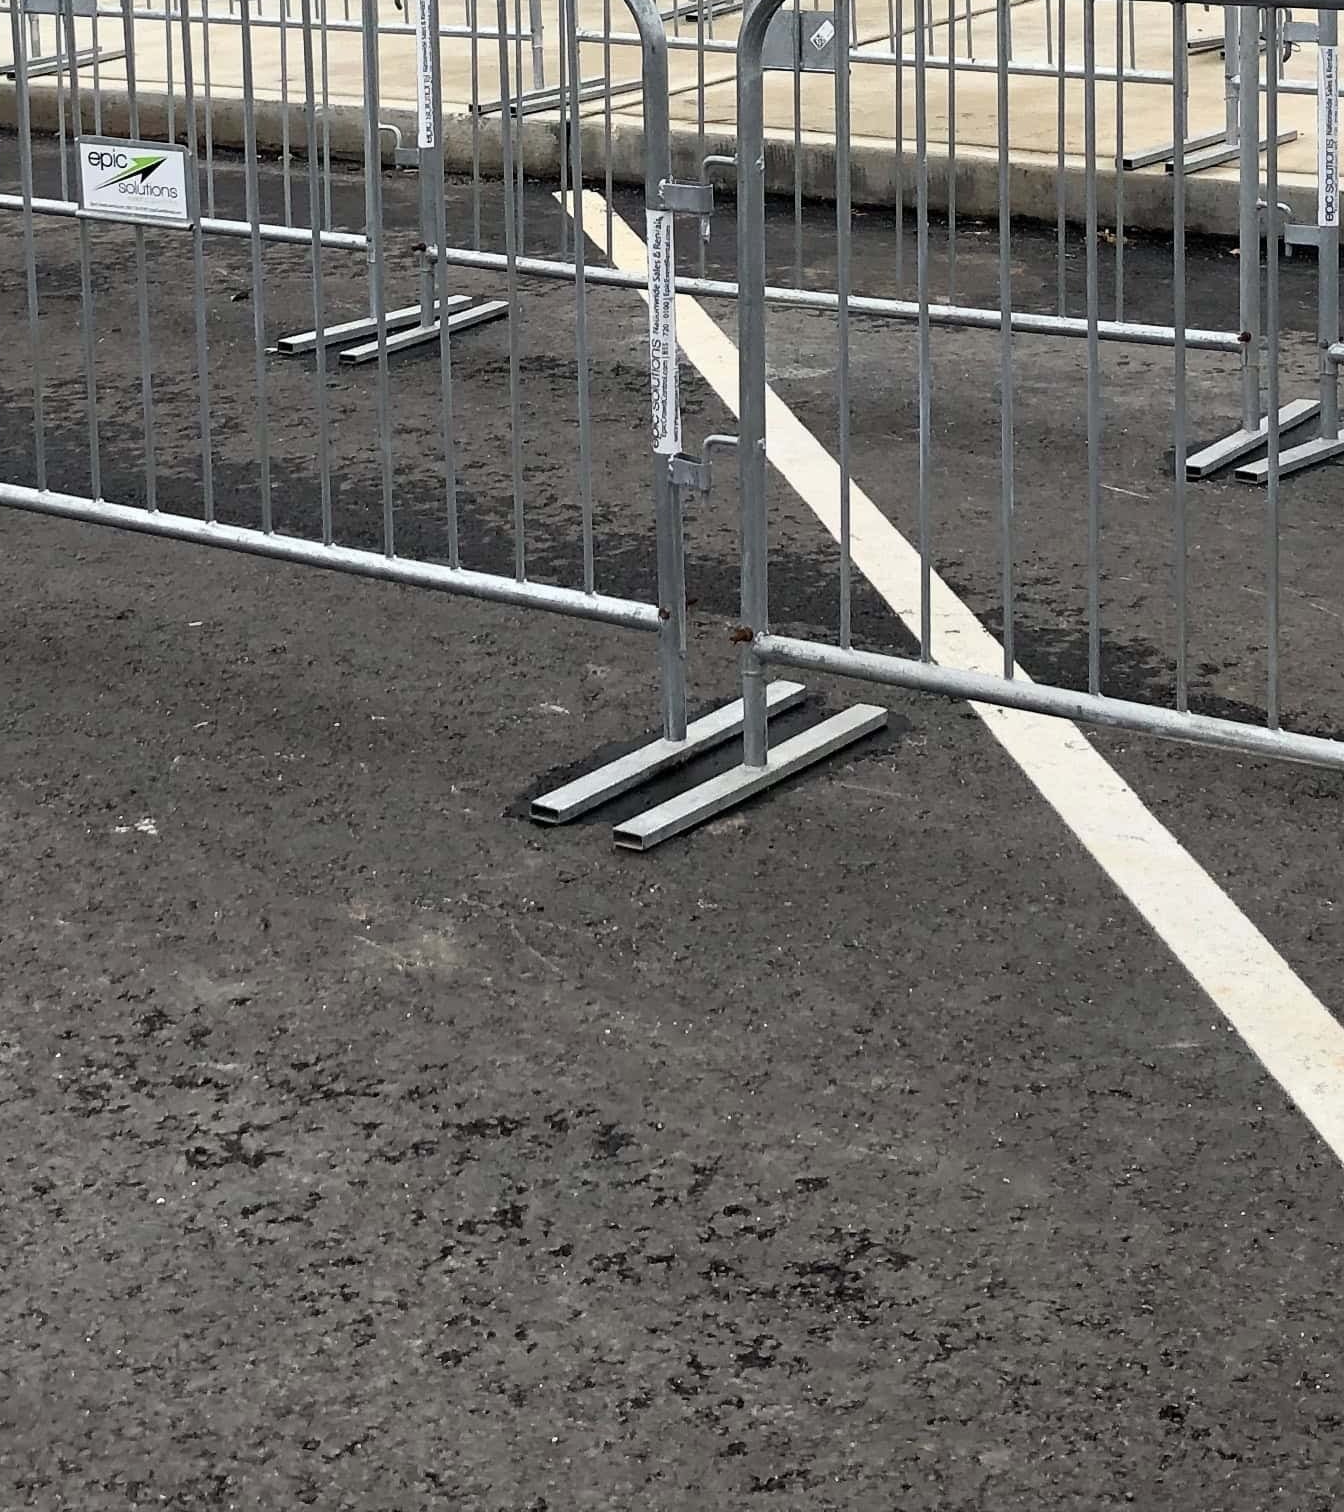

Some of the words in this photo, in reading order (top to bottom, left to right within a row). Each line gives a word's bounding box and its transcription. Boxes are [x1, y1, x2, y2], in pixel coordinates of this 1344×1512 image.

[87, 147, 128, 170] epic
[1325, 139, 1334, 193] solutions
[118, 180, 178, 198] solutions
[1325, 195, 1335, 221] epic
[652, 260, 661, 282] Sales
[651, 338, 661, 411] solutions
